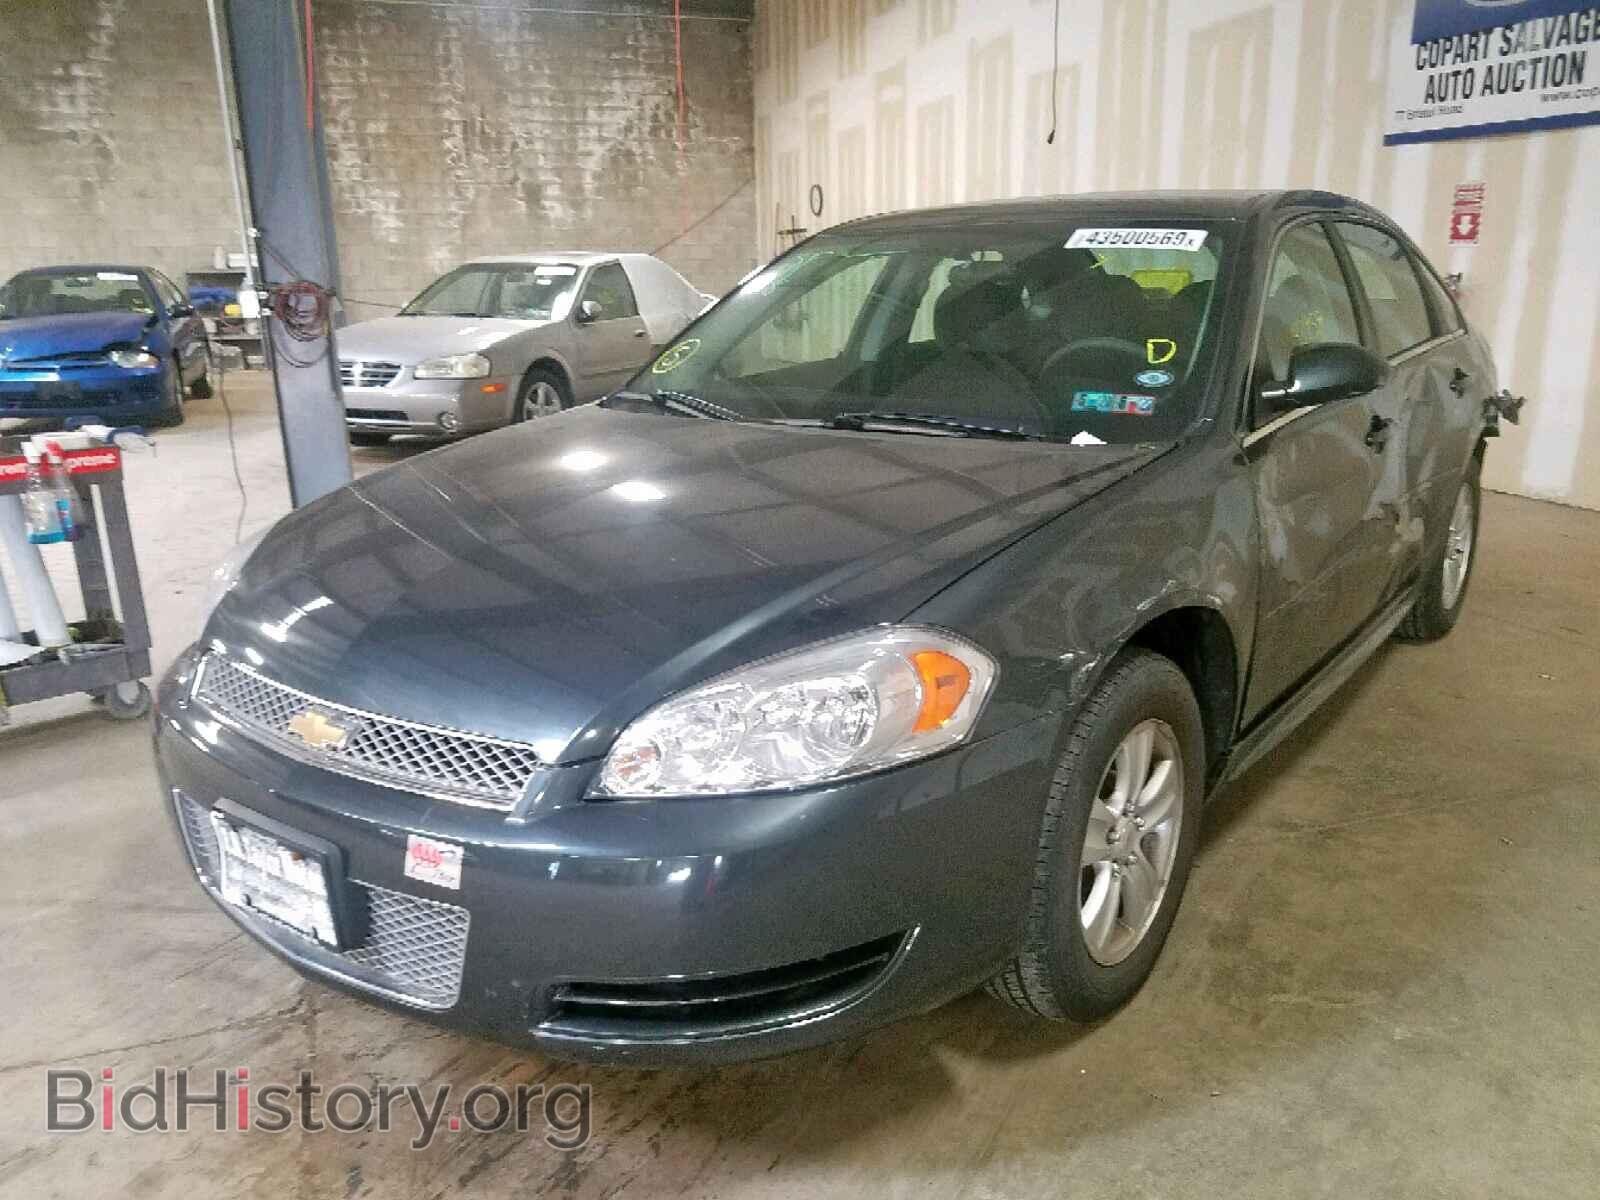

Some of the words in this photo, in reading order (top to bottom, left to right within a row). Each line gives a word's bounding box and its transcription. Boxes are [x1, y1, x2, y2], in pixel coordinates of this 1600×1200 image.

[1415, 30, 1491, 71] COPART
[1424, 67, 1475, 104] AUTO
[1482, 50, 1586, 97] AUCTION
[1085, 230, 1188, 245] 43500569
[1146, 338, 1177, 364] D
